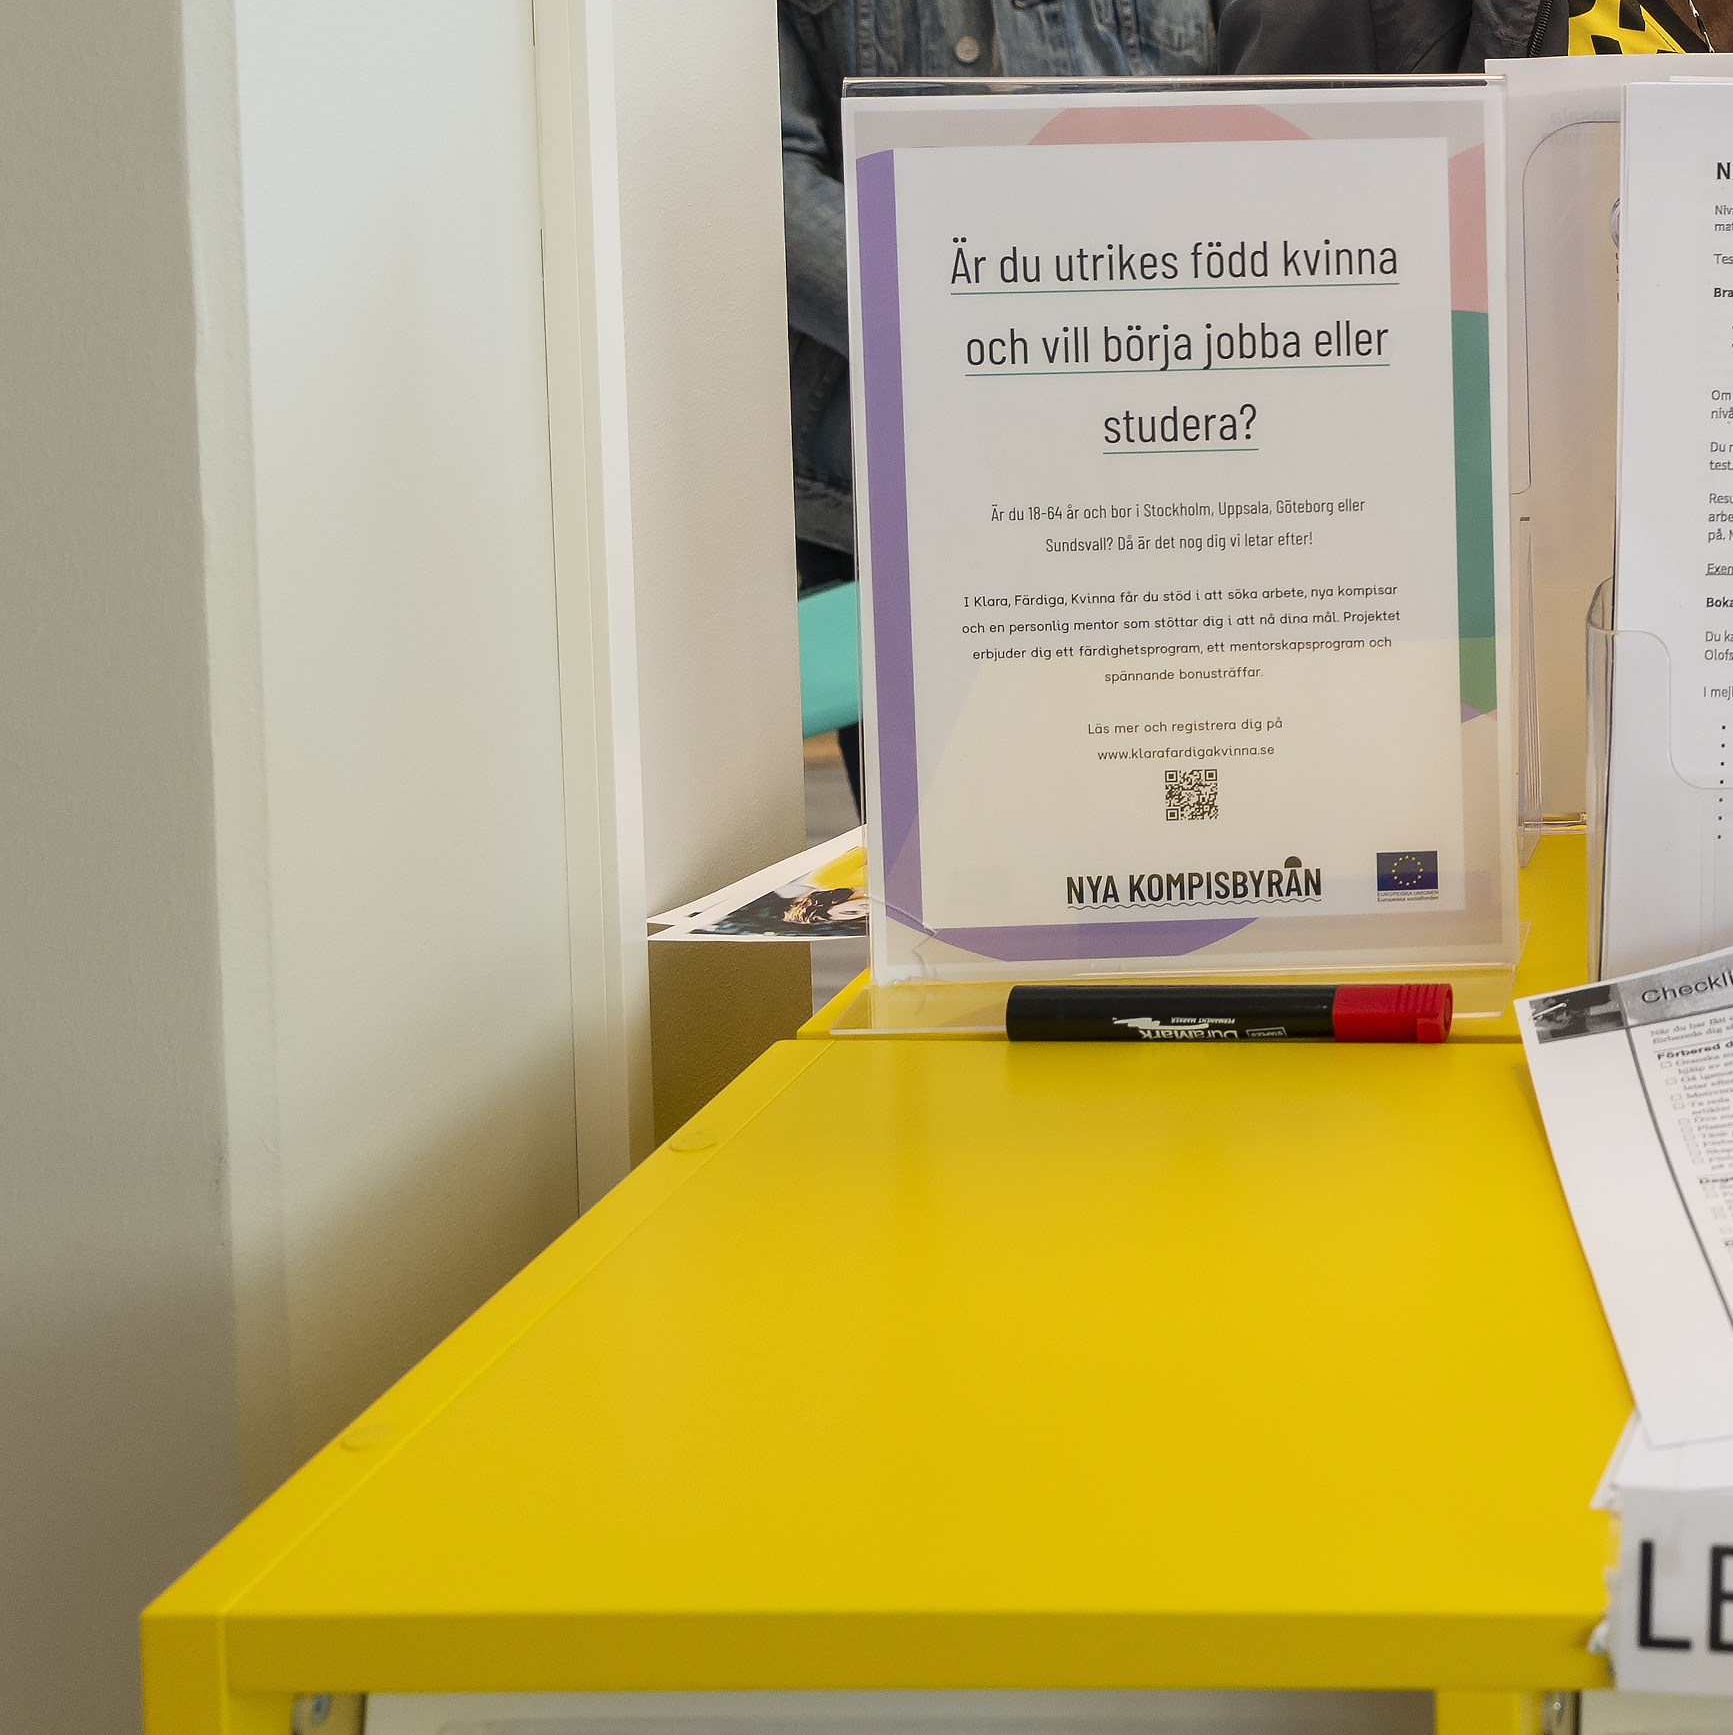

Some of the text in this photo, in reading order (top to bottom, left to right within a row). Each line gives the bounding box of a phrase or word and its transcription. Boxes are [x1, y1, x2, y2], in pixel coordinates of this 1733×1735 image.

[950, 236, 1397, 284] Är du utrikes född kvinna
[1713, 287, 1733, 298] Bra
[967, 320, 1389, 371] och vill börja jobba eller
[1104, 403, 1256, 444] studera?
[991, 498, 1365, 522] Är du 18-64 år och bor i Stockholm, Uppsala, Göteborg eller
[1045, 531, 1312, 552] Sundsvall? Då är det nog dig vi letar efter!
[1104, 666, 1263, 684] spännande bonusträffar.
[1703, 686, 1706, 698] I
[1087, 716, 1282, 735] Läs mer och registrera dig på
[1097, 745, 1274, 760] www.klarafardigakvinna.se
[1066, 855, 1321, 904] NYA KOMPISBYRÅN
[1138, 1028, 1239, 1041] DuraMark
[1657, 1042, 1721, 1060] Förbered
